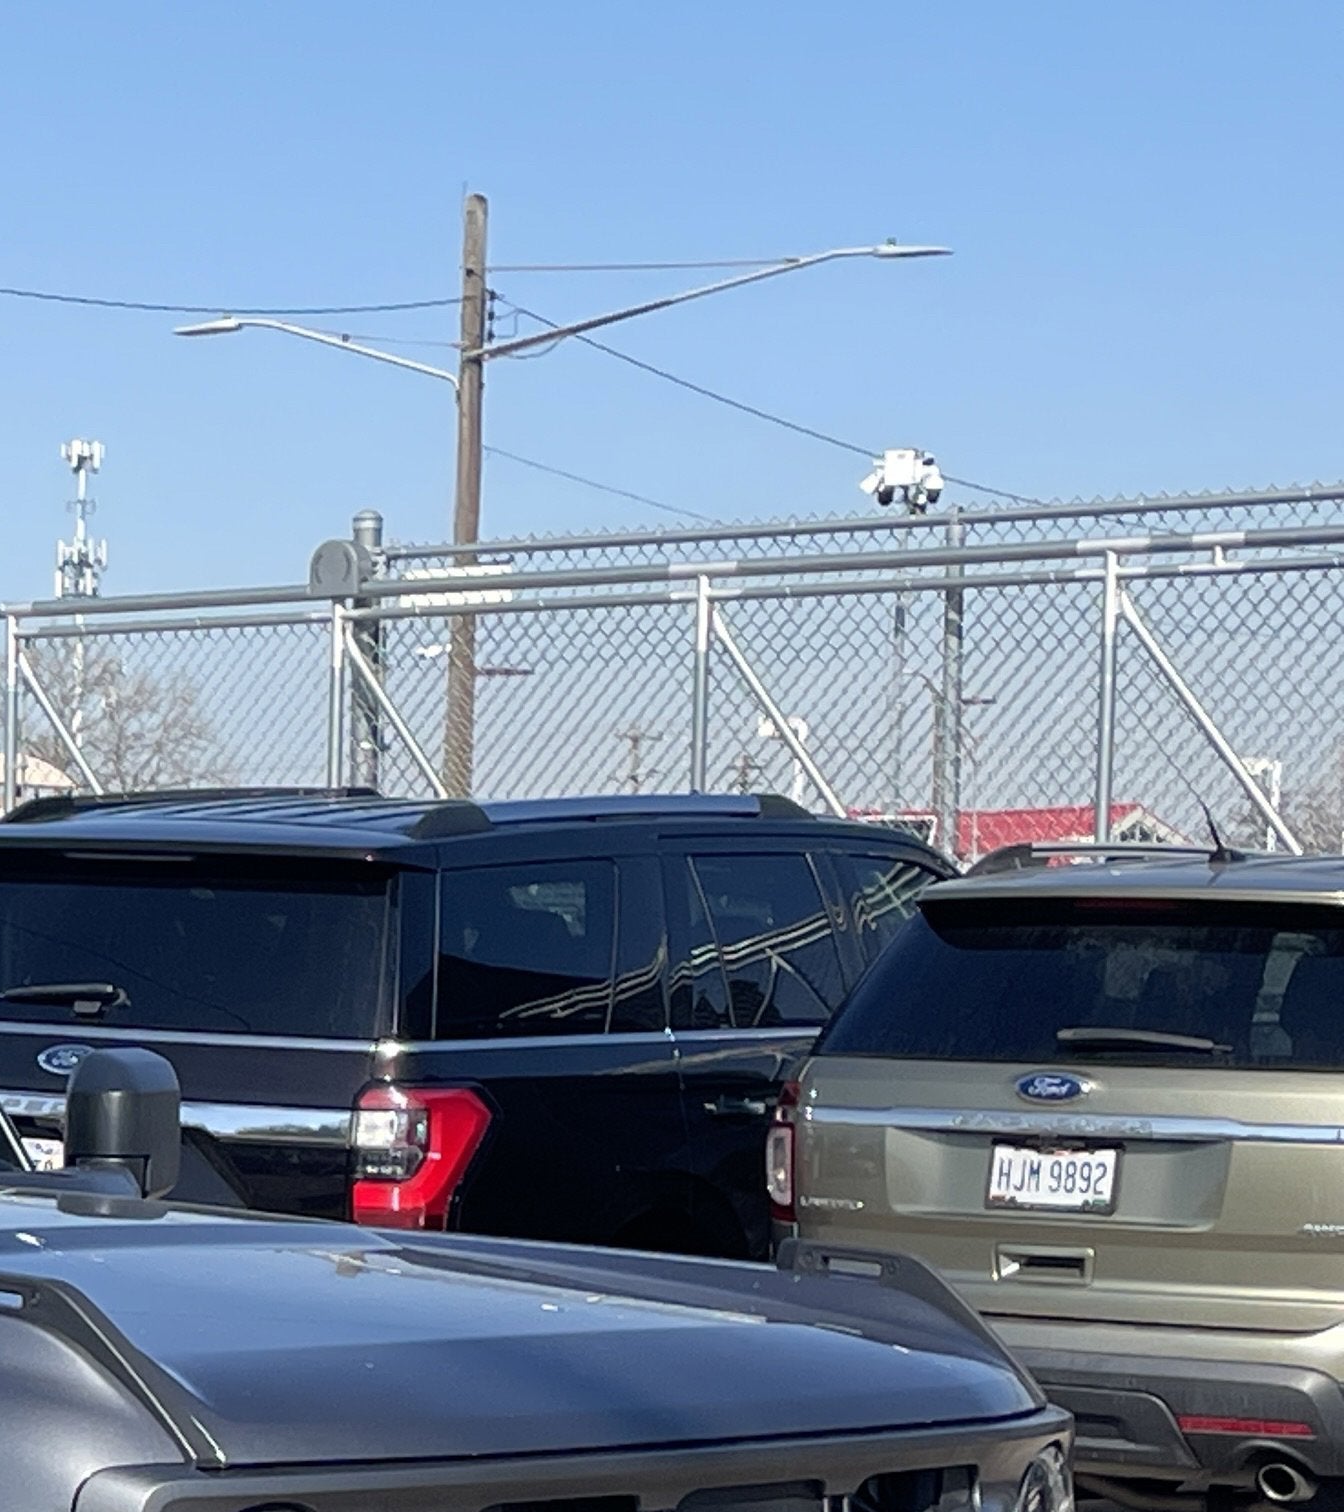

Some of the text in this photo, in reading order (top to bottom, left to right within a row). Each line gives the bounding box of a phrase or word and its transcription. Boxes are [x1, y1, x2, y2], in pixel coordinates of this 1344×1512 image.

[1027, 1077, 1072, 1097] Ford
[997, 1157, 1107, 1195] HJM 9892
